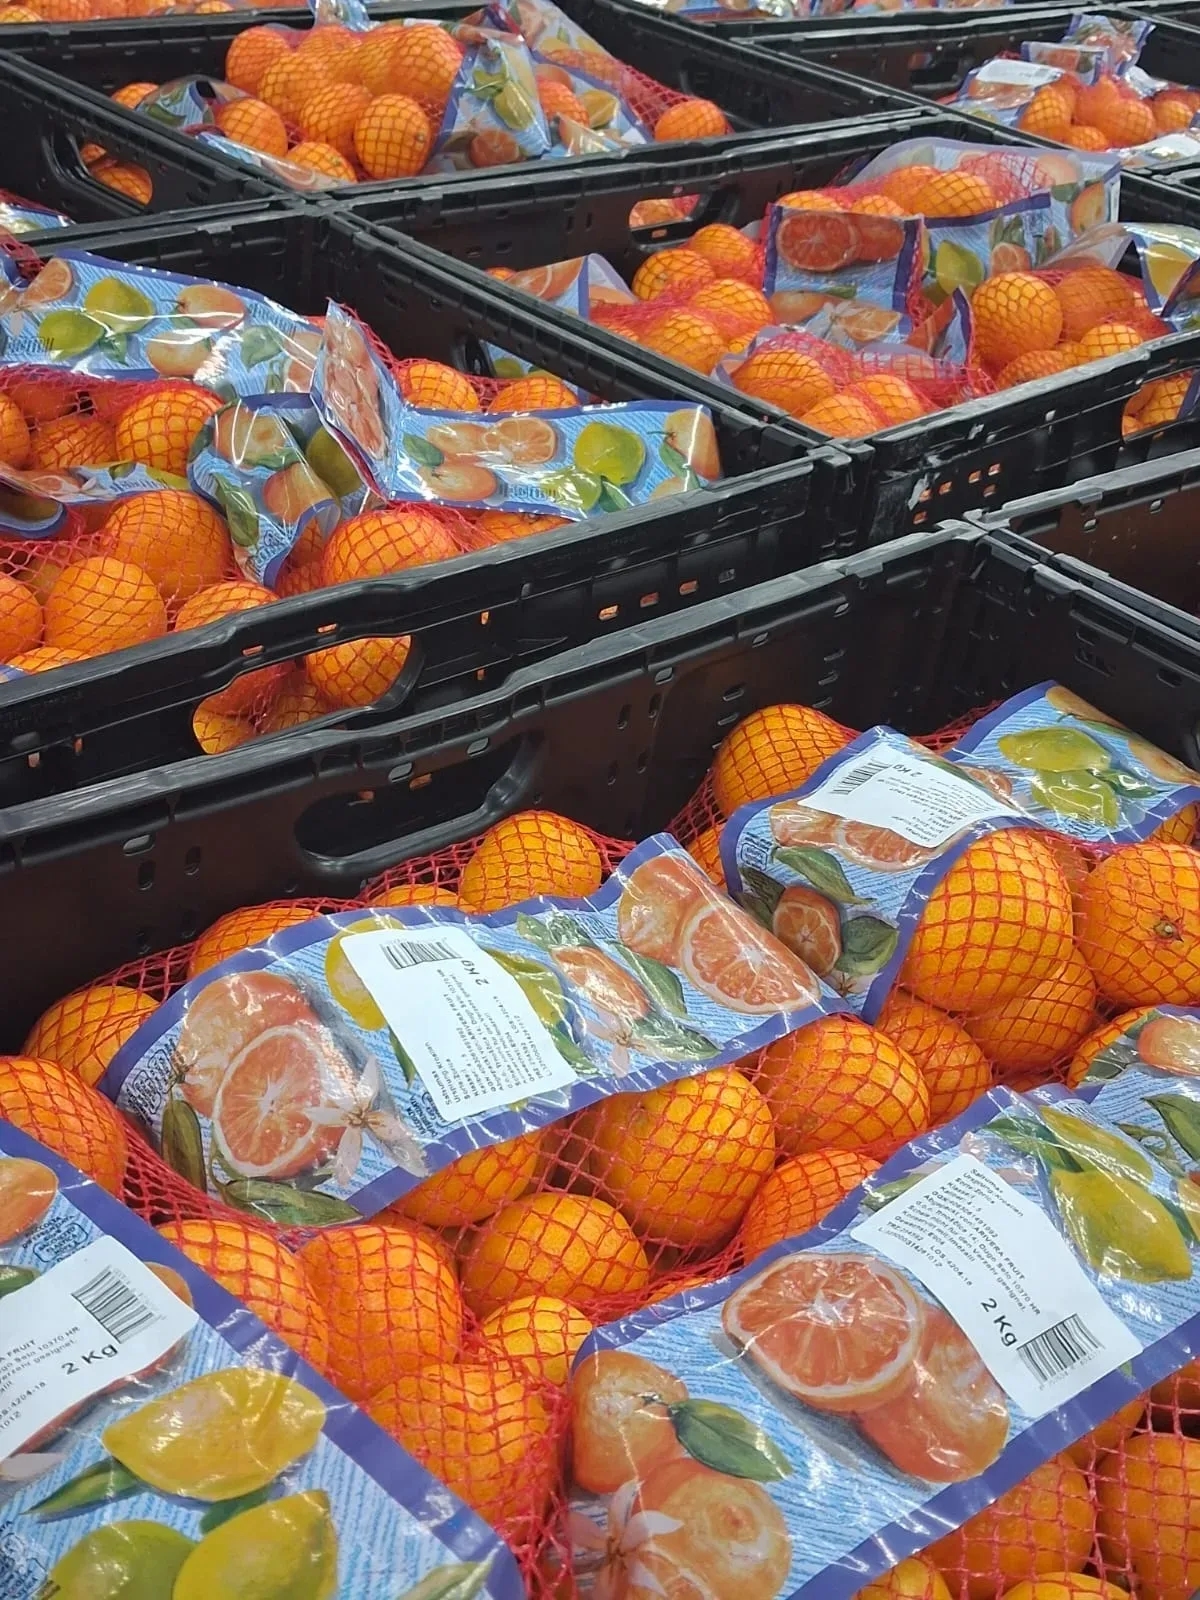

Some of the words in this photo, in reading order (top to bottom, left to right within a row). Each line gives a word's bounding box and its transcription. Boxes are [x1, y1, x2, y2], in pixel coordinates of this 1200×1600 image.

[461, 959, 480, 976] Kg
[474, 977, 490, 986] 2
[971, 1247, 999, 1277] Verzehr
[977, 1242, 997, 1262] Dugo
[996, 1261, 1012, 1280] Selo
[1011, 1279, 1031, 1302] 10370
[1003, 1255, 1025, 1280] FRUIT
[65, 1326, 80, 1338] HR
[981, 1297, 998, 1313] 2
[993, 1313, 1019, 1348] Kg
[6, 1339, 36, 1357] FRUIT
[61, 1362, 80, 1376] 2
[81, 1343, 119, 1365] Kg
